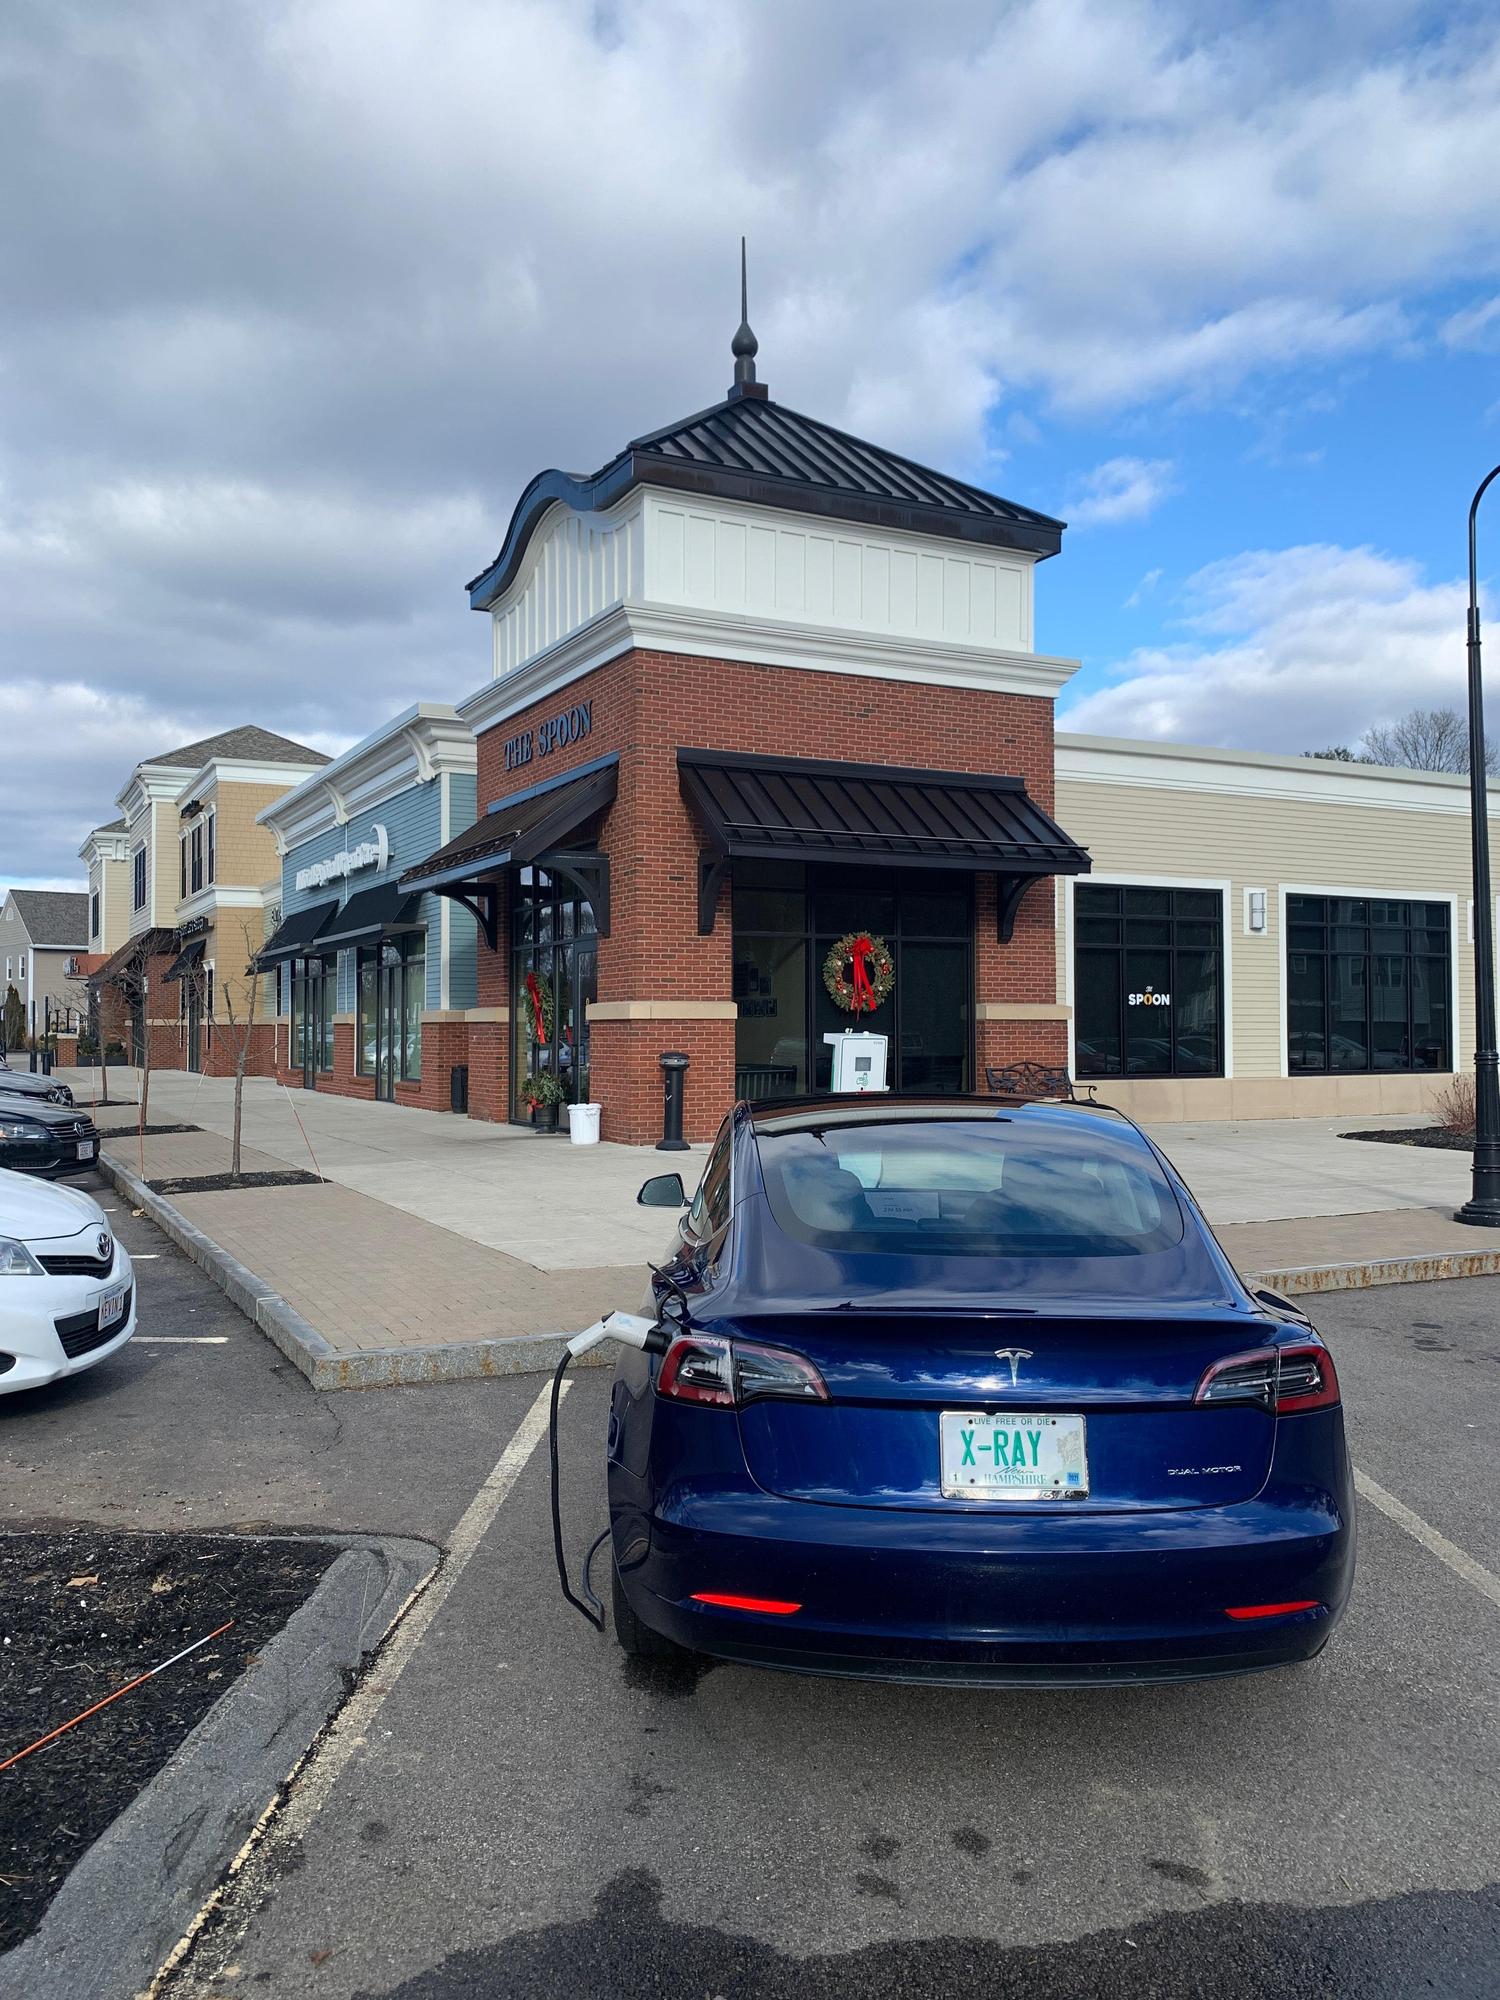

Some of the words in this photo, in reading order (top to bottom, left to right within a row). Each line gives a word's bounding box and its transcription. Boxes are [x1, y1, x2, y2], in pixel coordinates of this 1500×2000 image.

[504, 730, 533, 771] THE
[538, 699, 593, 757] SPOON
[1128, 993, 1170, 1005] SPOON
[974, 1417, 991, 1425] LIVE
[995, 1417, 1016, 1425] FREE
[1021, 1418, 1033, 1426] OR
[1037, 1418, 1050, 1426] DIE
[960, 1429, 1042, 1467] X-RAY
[1167, 1468, 1200, 1476] DUAL
[1202, 1465, 1243, 1474] MOTOR
[983, 1473, 1048, 1486] HAMPSHIRE
